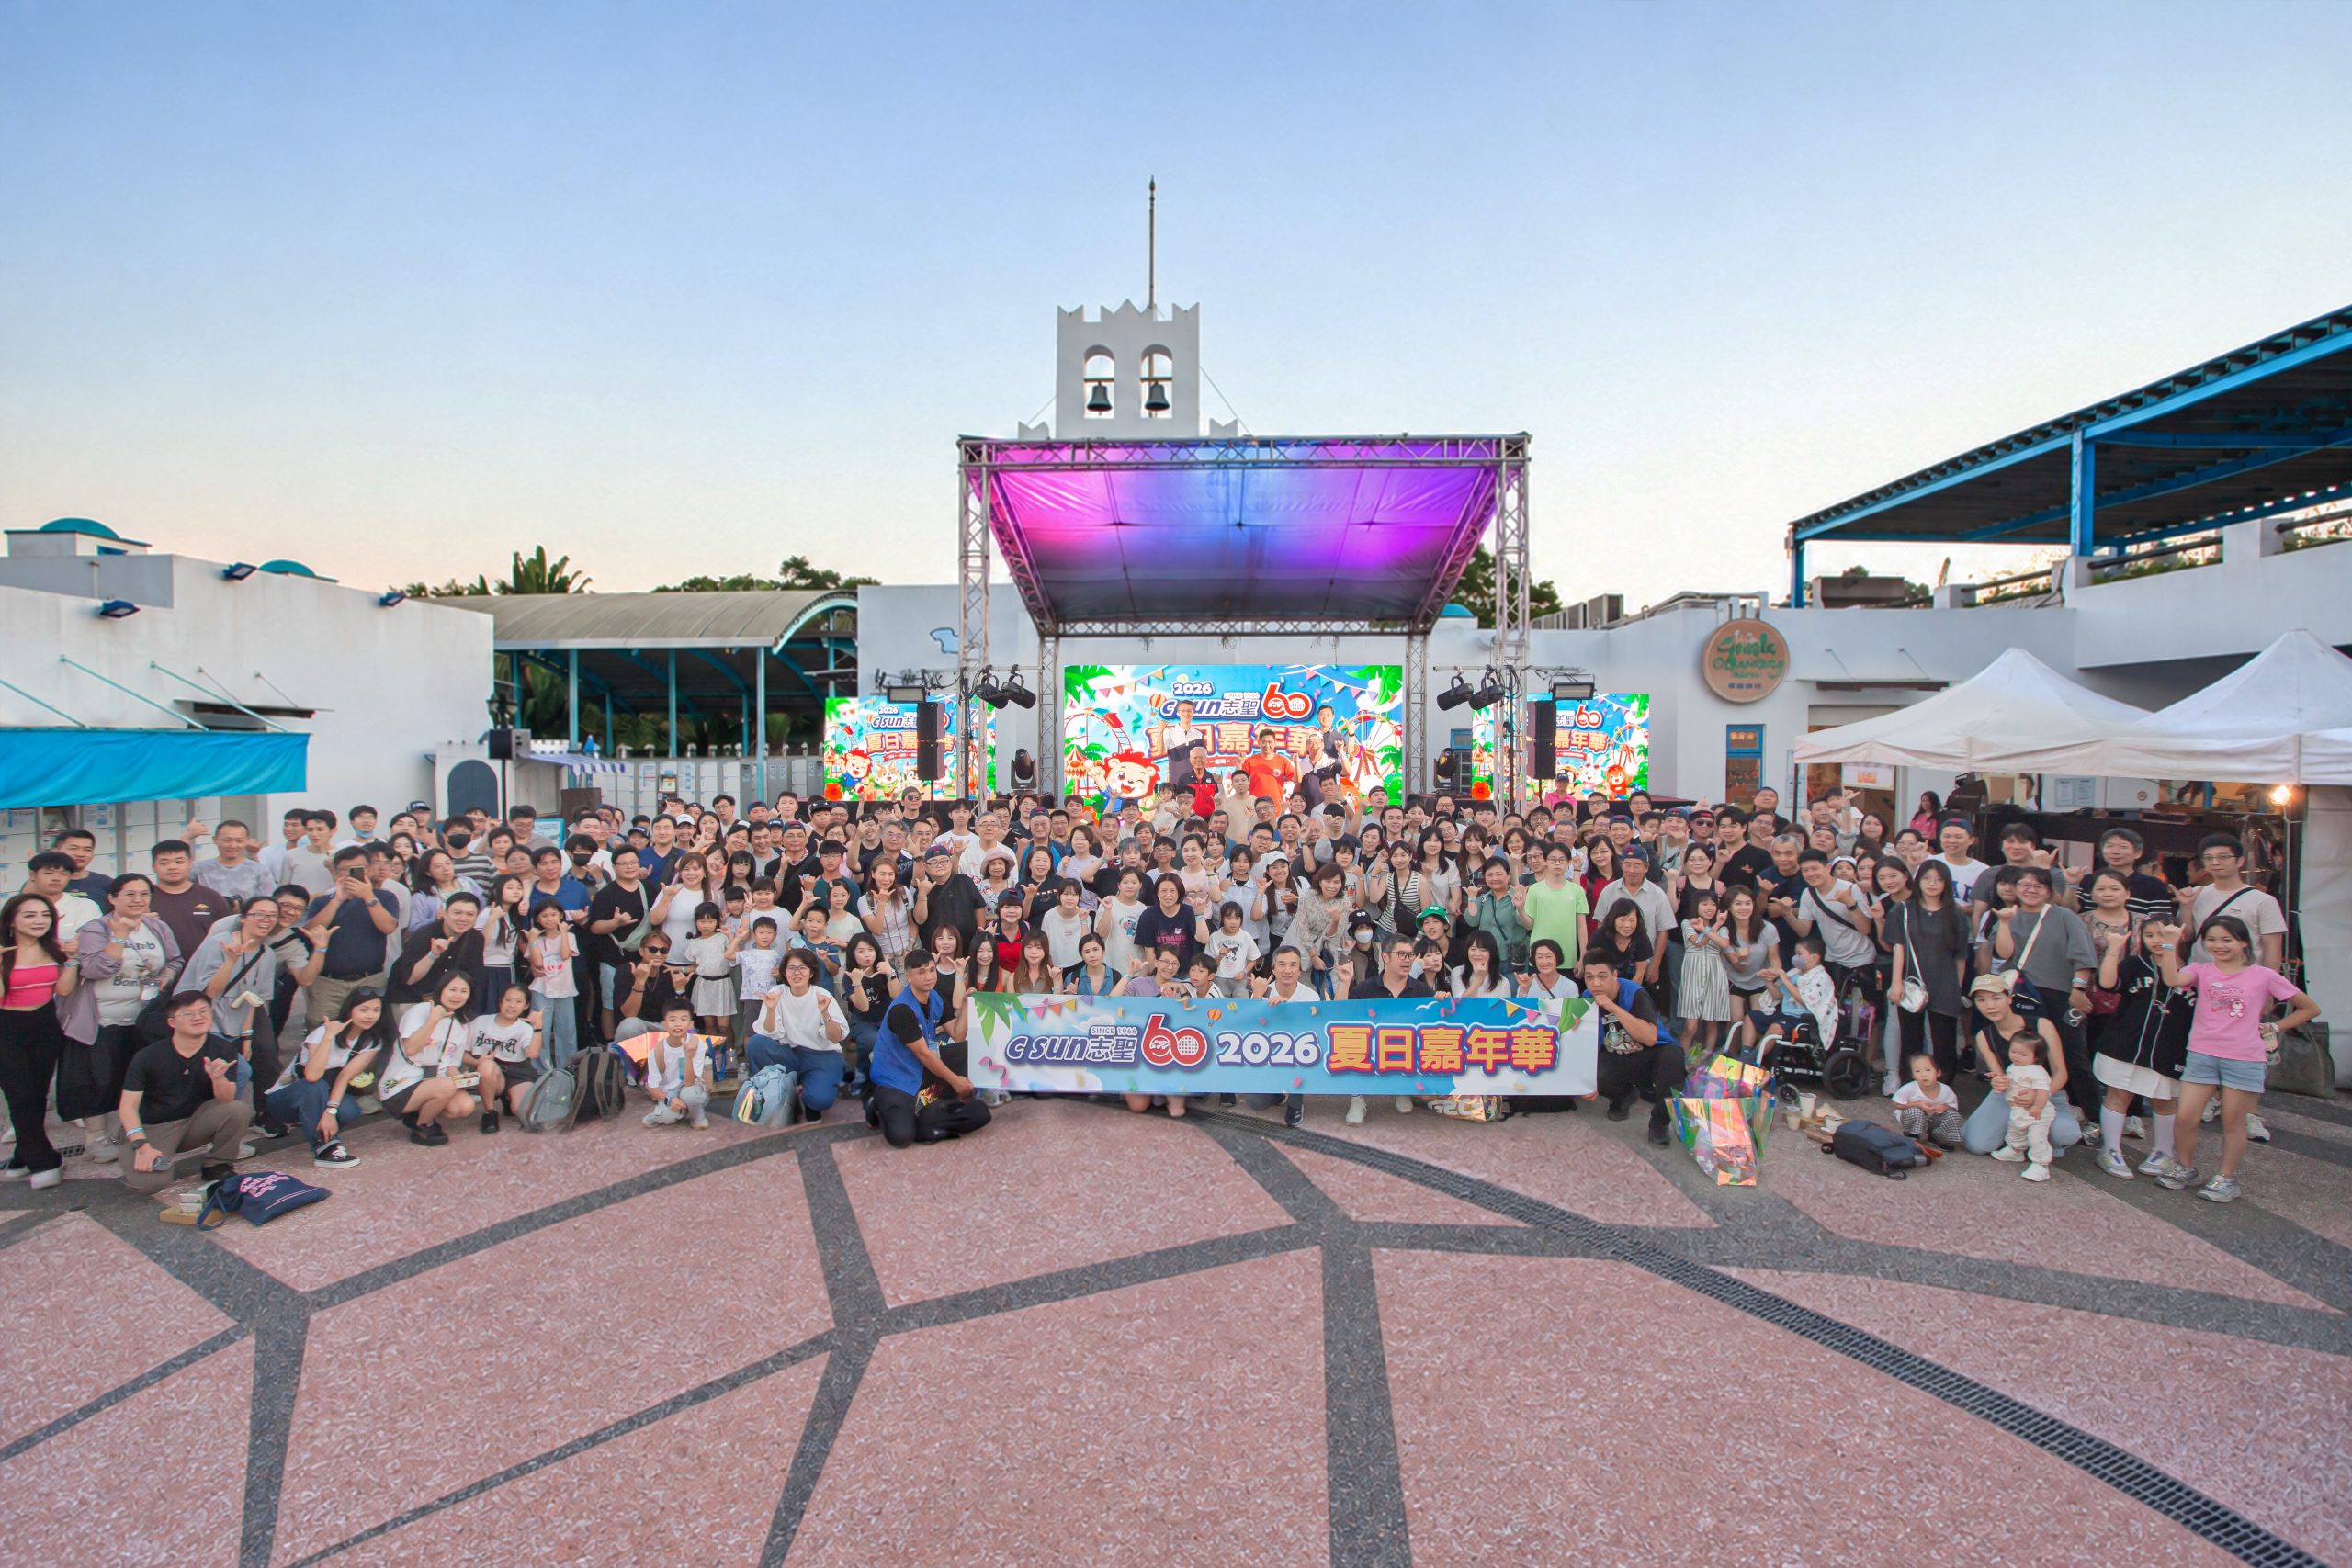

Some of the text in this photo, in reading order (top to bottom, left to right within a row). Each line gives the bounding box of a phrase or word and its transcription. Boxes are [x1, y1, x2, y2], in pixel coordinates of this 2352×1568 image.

[1174, 682, 1212, 694] 2026
[878, 706, 899, 715] 2026
[1263, 684, 1310, 716] 60
[1577, 705, 1600, 726] 60
[1555, 728, 1608, 752] 嘉年華
[1092, 1027, 1136, 1035] SINCE 1966
[1087, 1038, 1136, 1063] 志聖
[1142, 1014, 1207, 1066] 60
[1218, 1033, 1319, 1064] 2026
[1329, 1026, 1555, 1073] 夏日嘉年華
